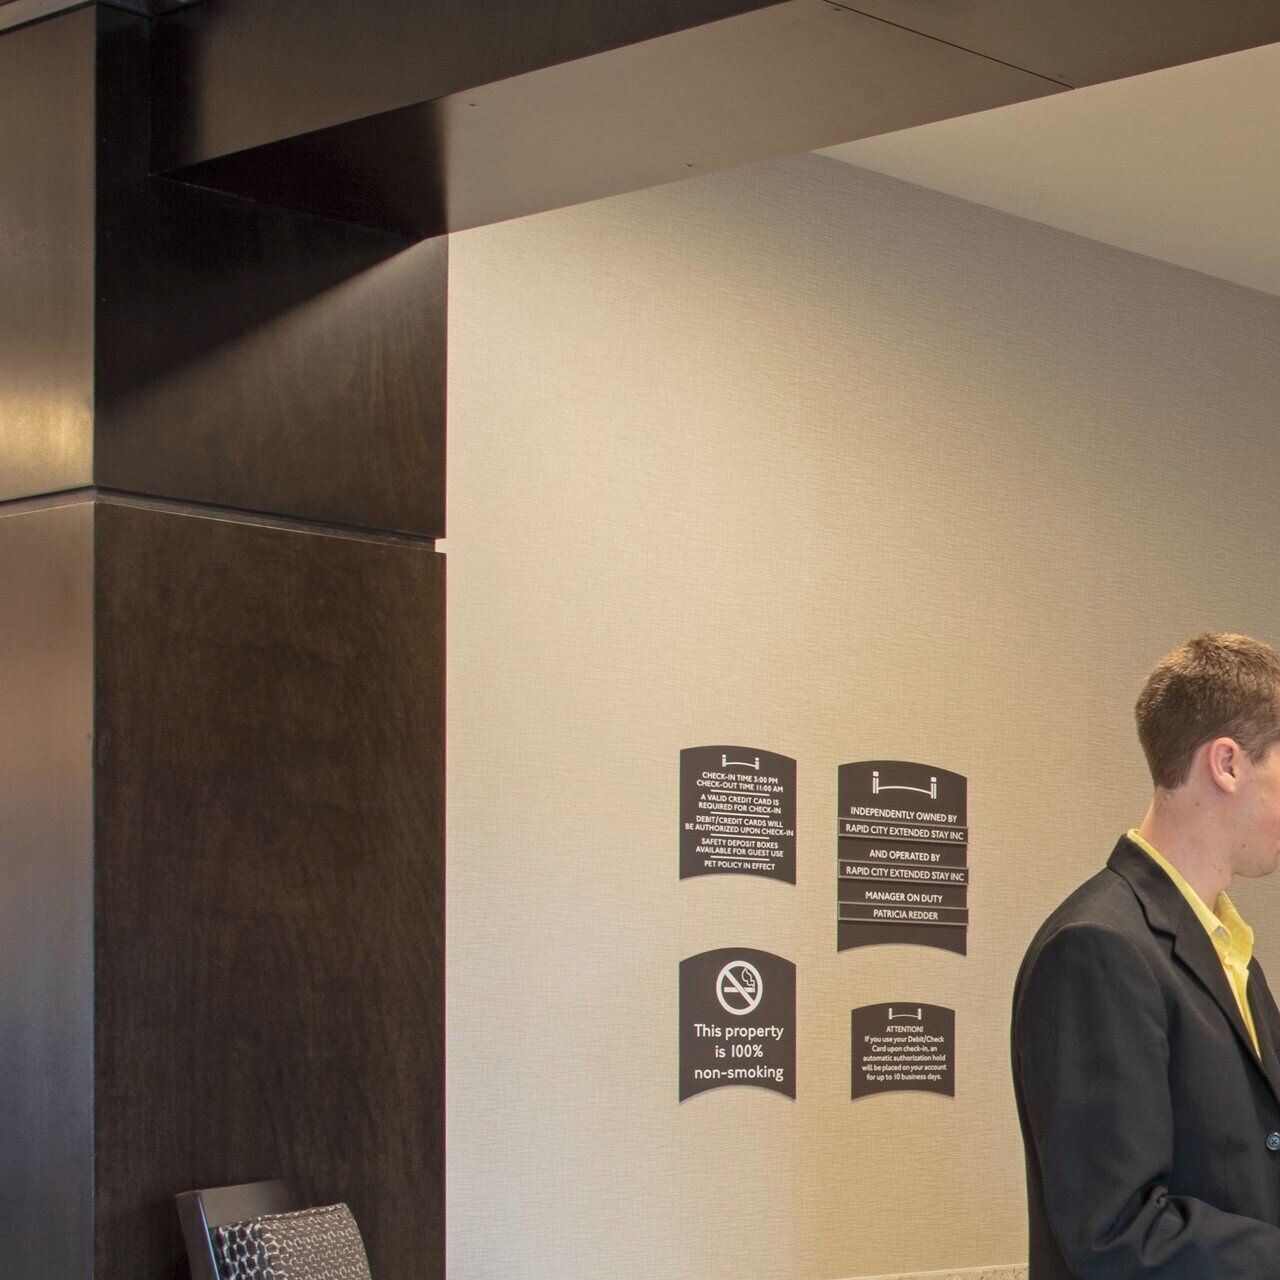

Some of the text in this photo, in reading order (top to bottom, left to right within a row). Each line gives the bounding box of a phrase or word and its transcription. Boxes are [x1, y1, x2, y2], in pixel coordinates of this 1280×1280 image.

[702, 772, 736, 782] CHECK-IN
[768, 776, 778, 784] PM
[697, 780, 738, 789] CHECK-OUT
[707, 794, 727, 802] VALID
[728, 796, 752, 804] CREDIT
[753, 797, 772, 805] CARD
[699, 802, 732, 811] REQUIRED
[749, 806, 781, 814] CHECK-IN
[850, 806, 958, 823] INDEPENDENTLY OWNED BY
[696, 815, 783, 828] DEBIT/CREDIT CARDS WILL
[695, 824, 739, 833] AUTHORIZED
[762, 828, 794, 836] CHECK-IN
[845, 824, 964, 840] RAPID CITY EXTENDED STAY INC
[702, 838, 778, 849] SAFETY DEPOSIT BOXES
[696, 846, 732, 854] AVAILABLE
[869, 849, 940, 862] AND OPERATED BY
[718, 860, 742, 869] POLICY
[752, 862, 775, 870] EFFECT
[846, 866, 964, 881] RAPID CITY EXTENDED STAY INC
[865, 891, 943, 903] MANAGER ON DUTY
[873, 909, 938, 920] PATRICIA REDDER
[694, 1024, 784, 1040] This property
[865, 1035, 870, 1043] If
[908, 1035, 944, 1043] Debit/Check
[715, 1044, 763, 1058] is 100%
[695, 1065, 784, 1081] non-smoking
[882, 1064, 901, 1072] placed
[867, 1073, 876, 1081] for
